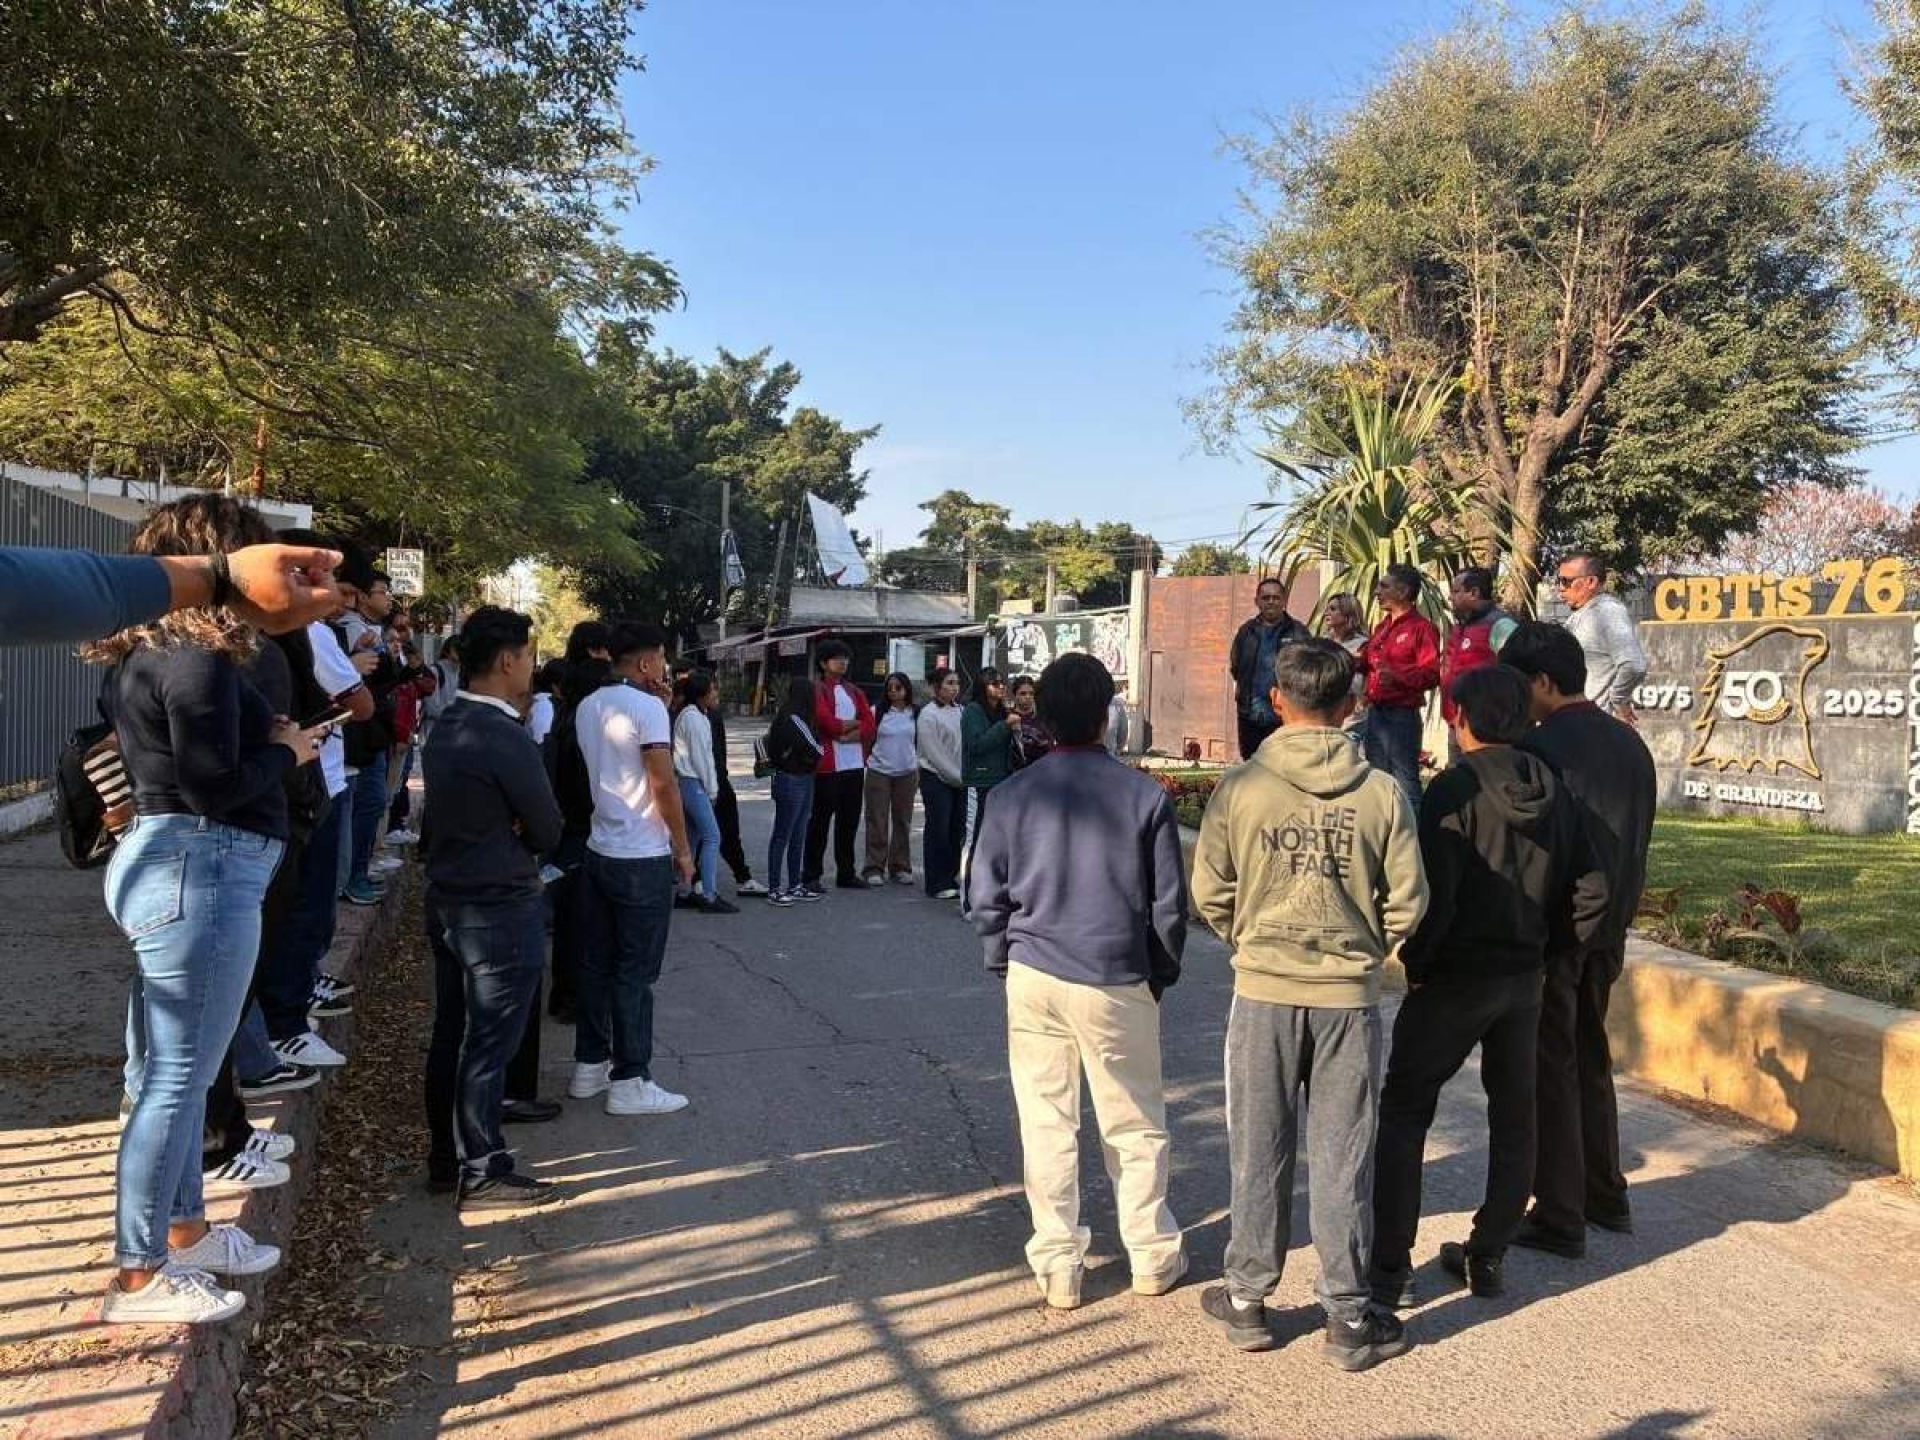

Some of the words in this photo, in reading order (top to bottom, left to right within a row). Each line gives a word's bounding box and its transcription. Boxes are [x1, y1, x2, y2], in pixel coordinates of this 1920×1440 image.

[1655, 573, 1812, 622] CBTis
[1822, 557, 1905, 617] 76
[1721, 670, 1783, 718] 50
[1823, 688, 1905, 716] 2025
[1684, 780, 1708, 798] DE
[1715, 783, 1824, 811] GRANDEZA
[1303, 804, 1356, 832] THE
[1260, 827, 1354, 857] NORTH
[1290, 852, 1351, 879] FACE
